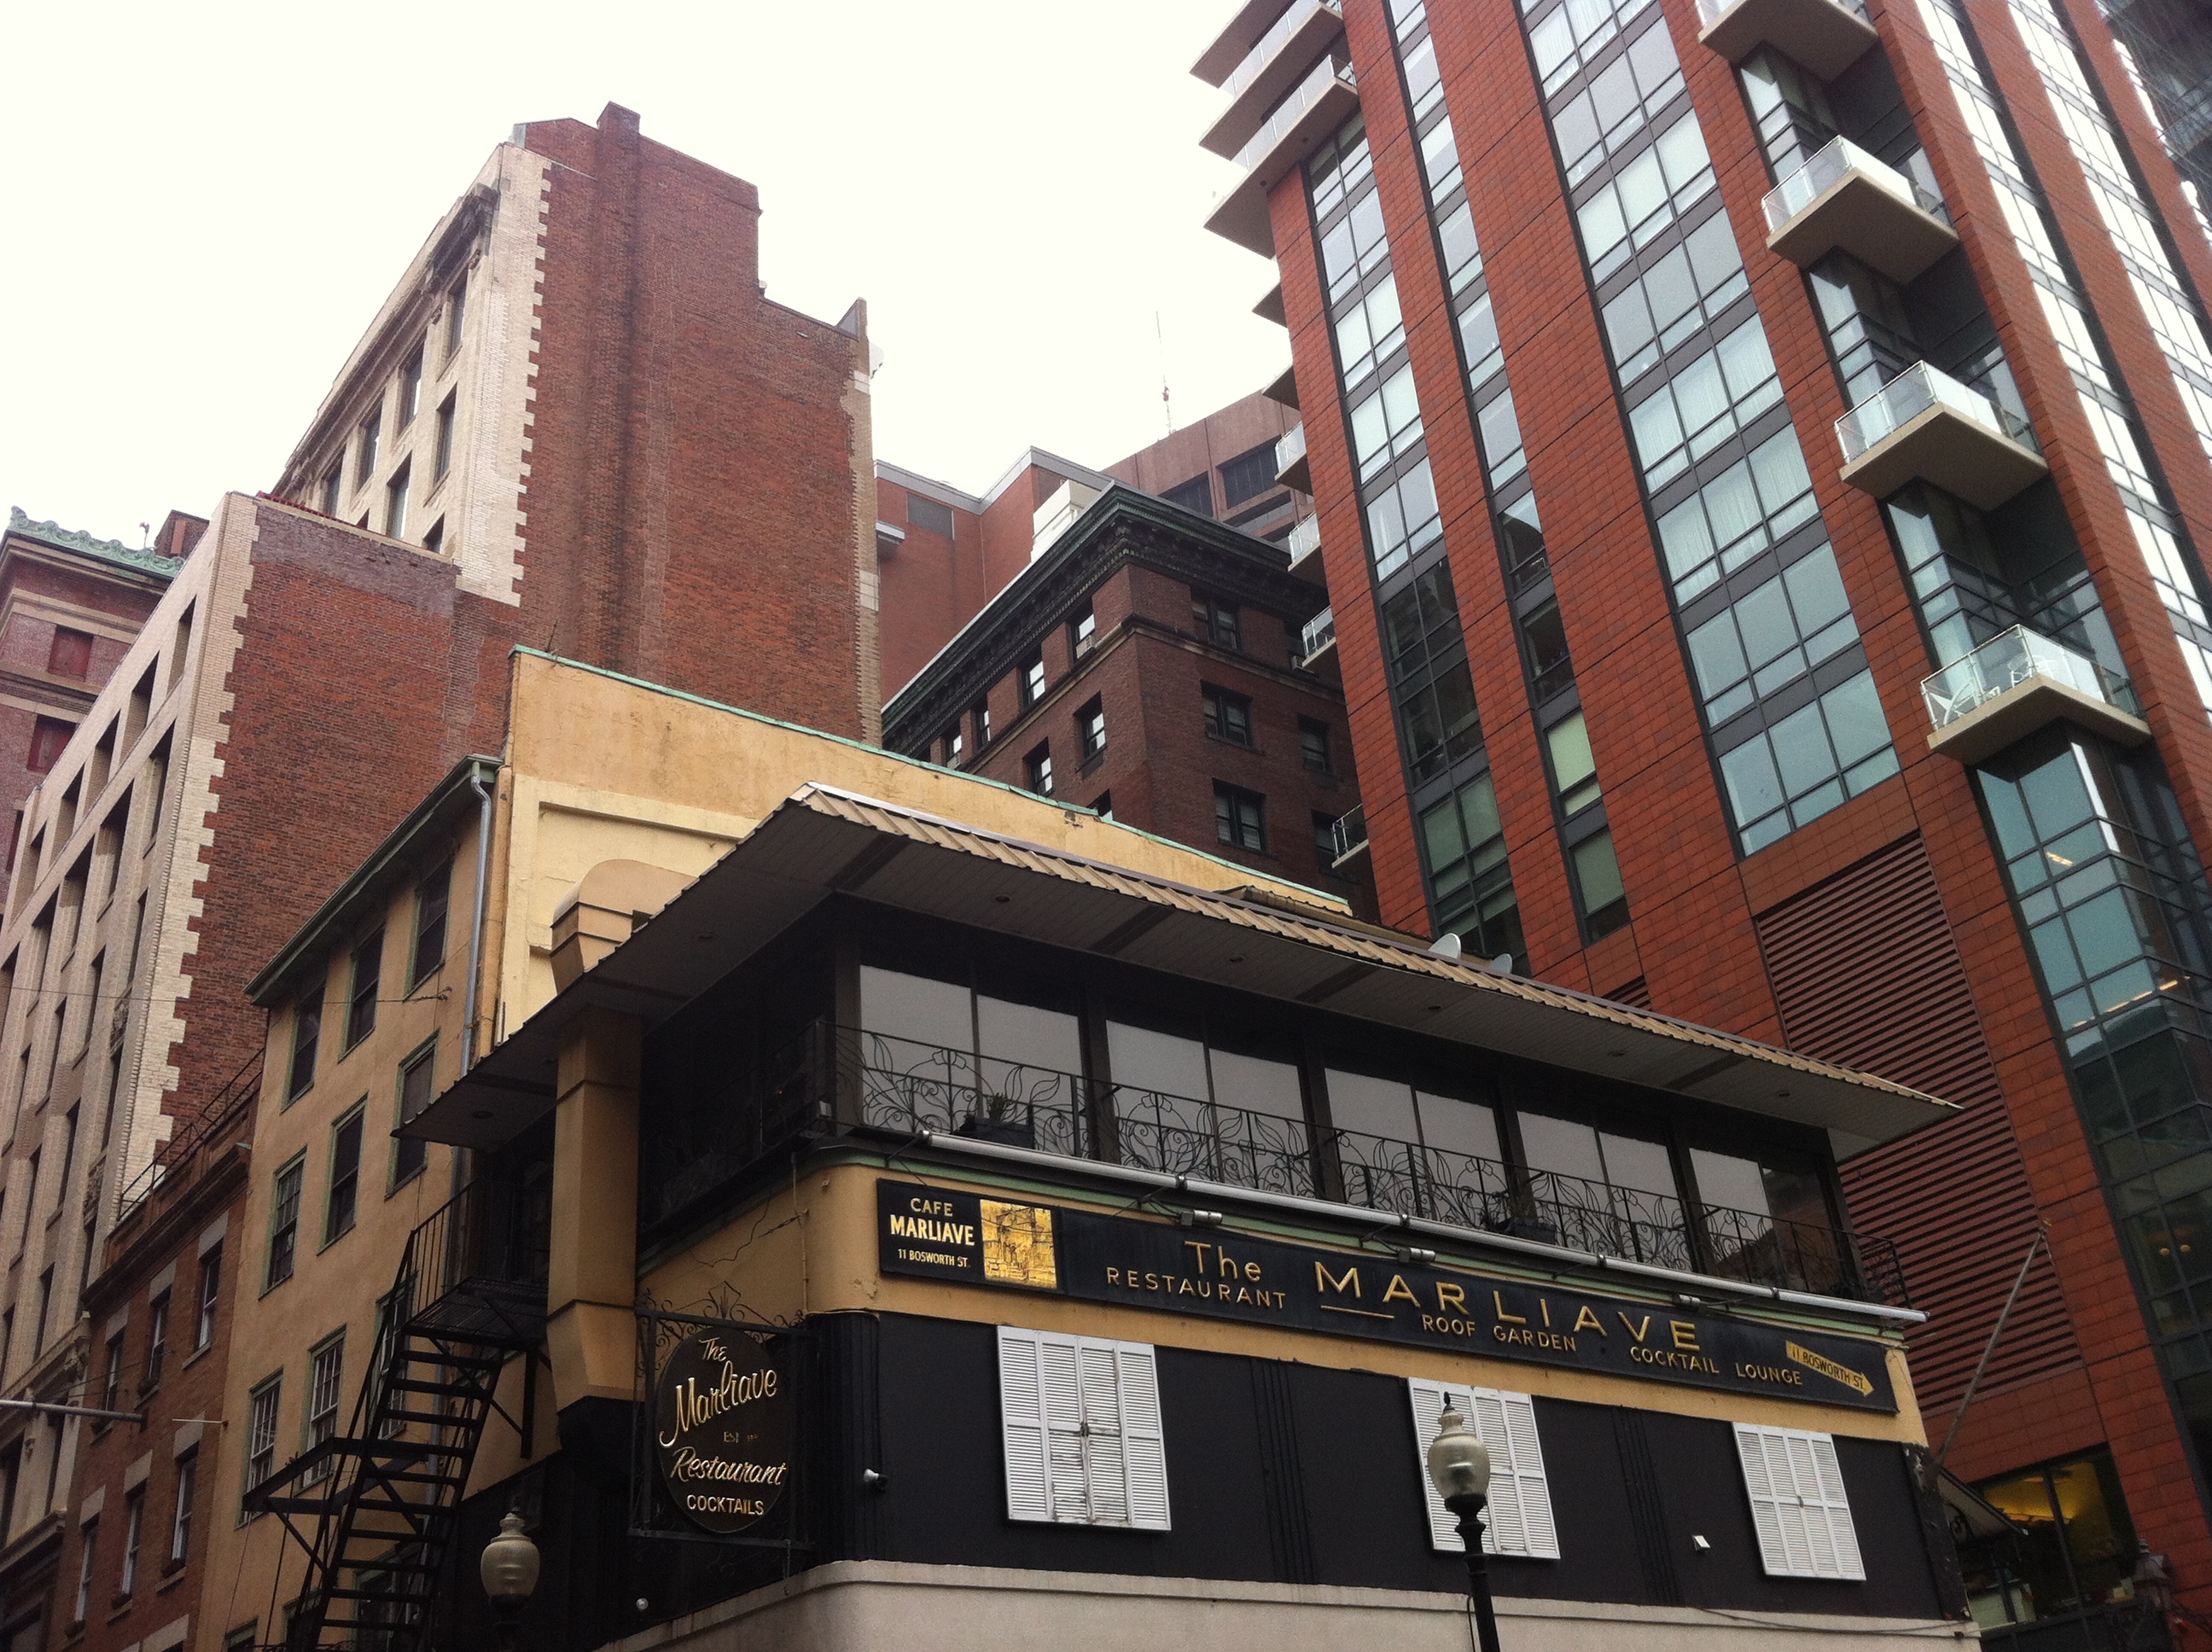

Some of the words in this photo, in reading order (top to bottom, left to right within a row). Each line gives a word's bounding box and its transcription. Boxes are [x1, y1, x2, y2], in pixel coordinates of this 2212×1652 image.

[910, 1197, 953, 1216] CAFE
[890, 1214, 975, 1246] MARLIAVE
[898, 1248, 907, 1259] 11
[909, 1249, 955, 1266] BOSWORTH
[1184, 1240, 1261, 1282] The
[1107, 1266, 1286, 1310] RESTAURANT
[1314, 1261, 1701, 1352] MARLIAVE
[698, 1336, 727, 1362] The
[1422, 1314, 1476, 1337] ROOF
[1493, 1325, 1576, 1352] GARDEN
[1630, 1346, 1720, 1375] COCKTAIL
[1735, 1362, 1803, 1386] LOUNGE
[1802, 1351, 1852, 1384] BOSWORTH
[659, 1360, 777, 1448] Marliave
[670, 1446, 787, 1486] Restaurant
[686, 1494, 764, 1515] COCKTAILS
